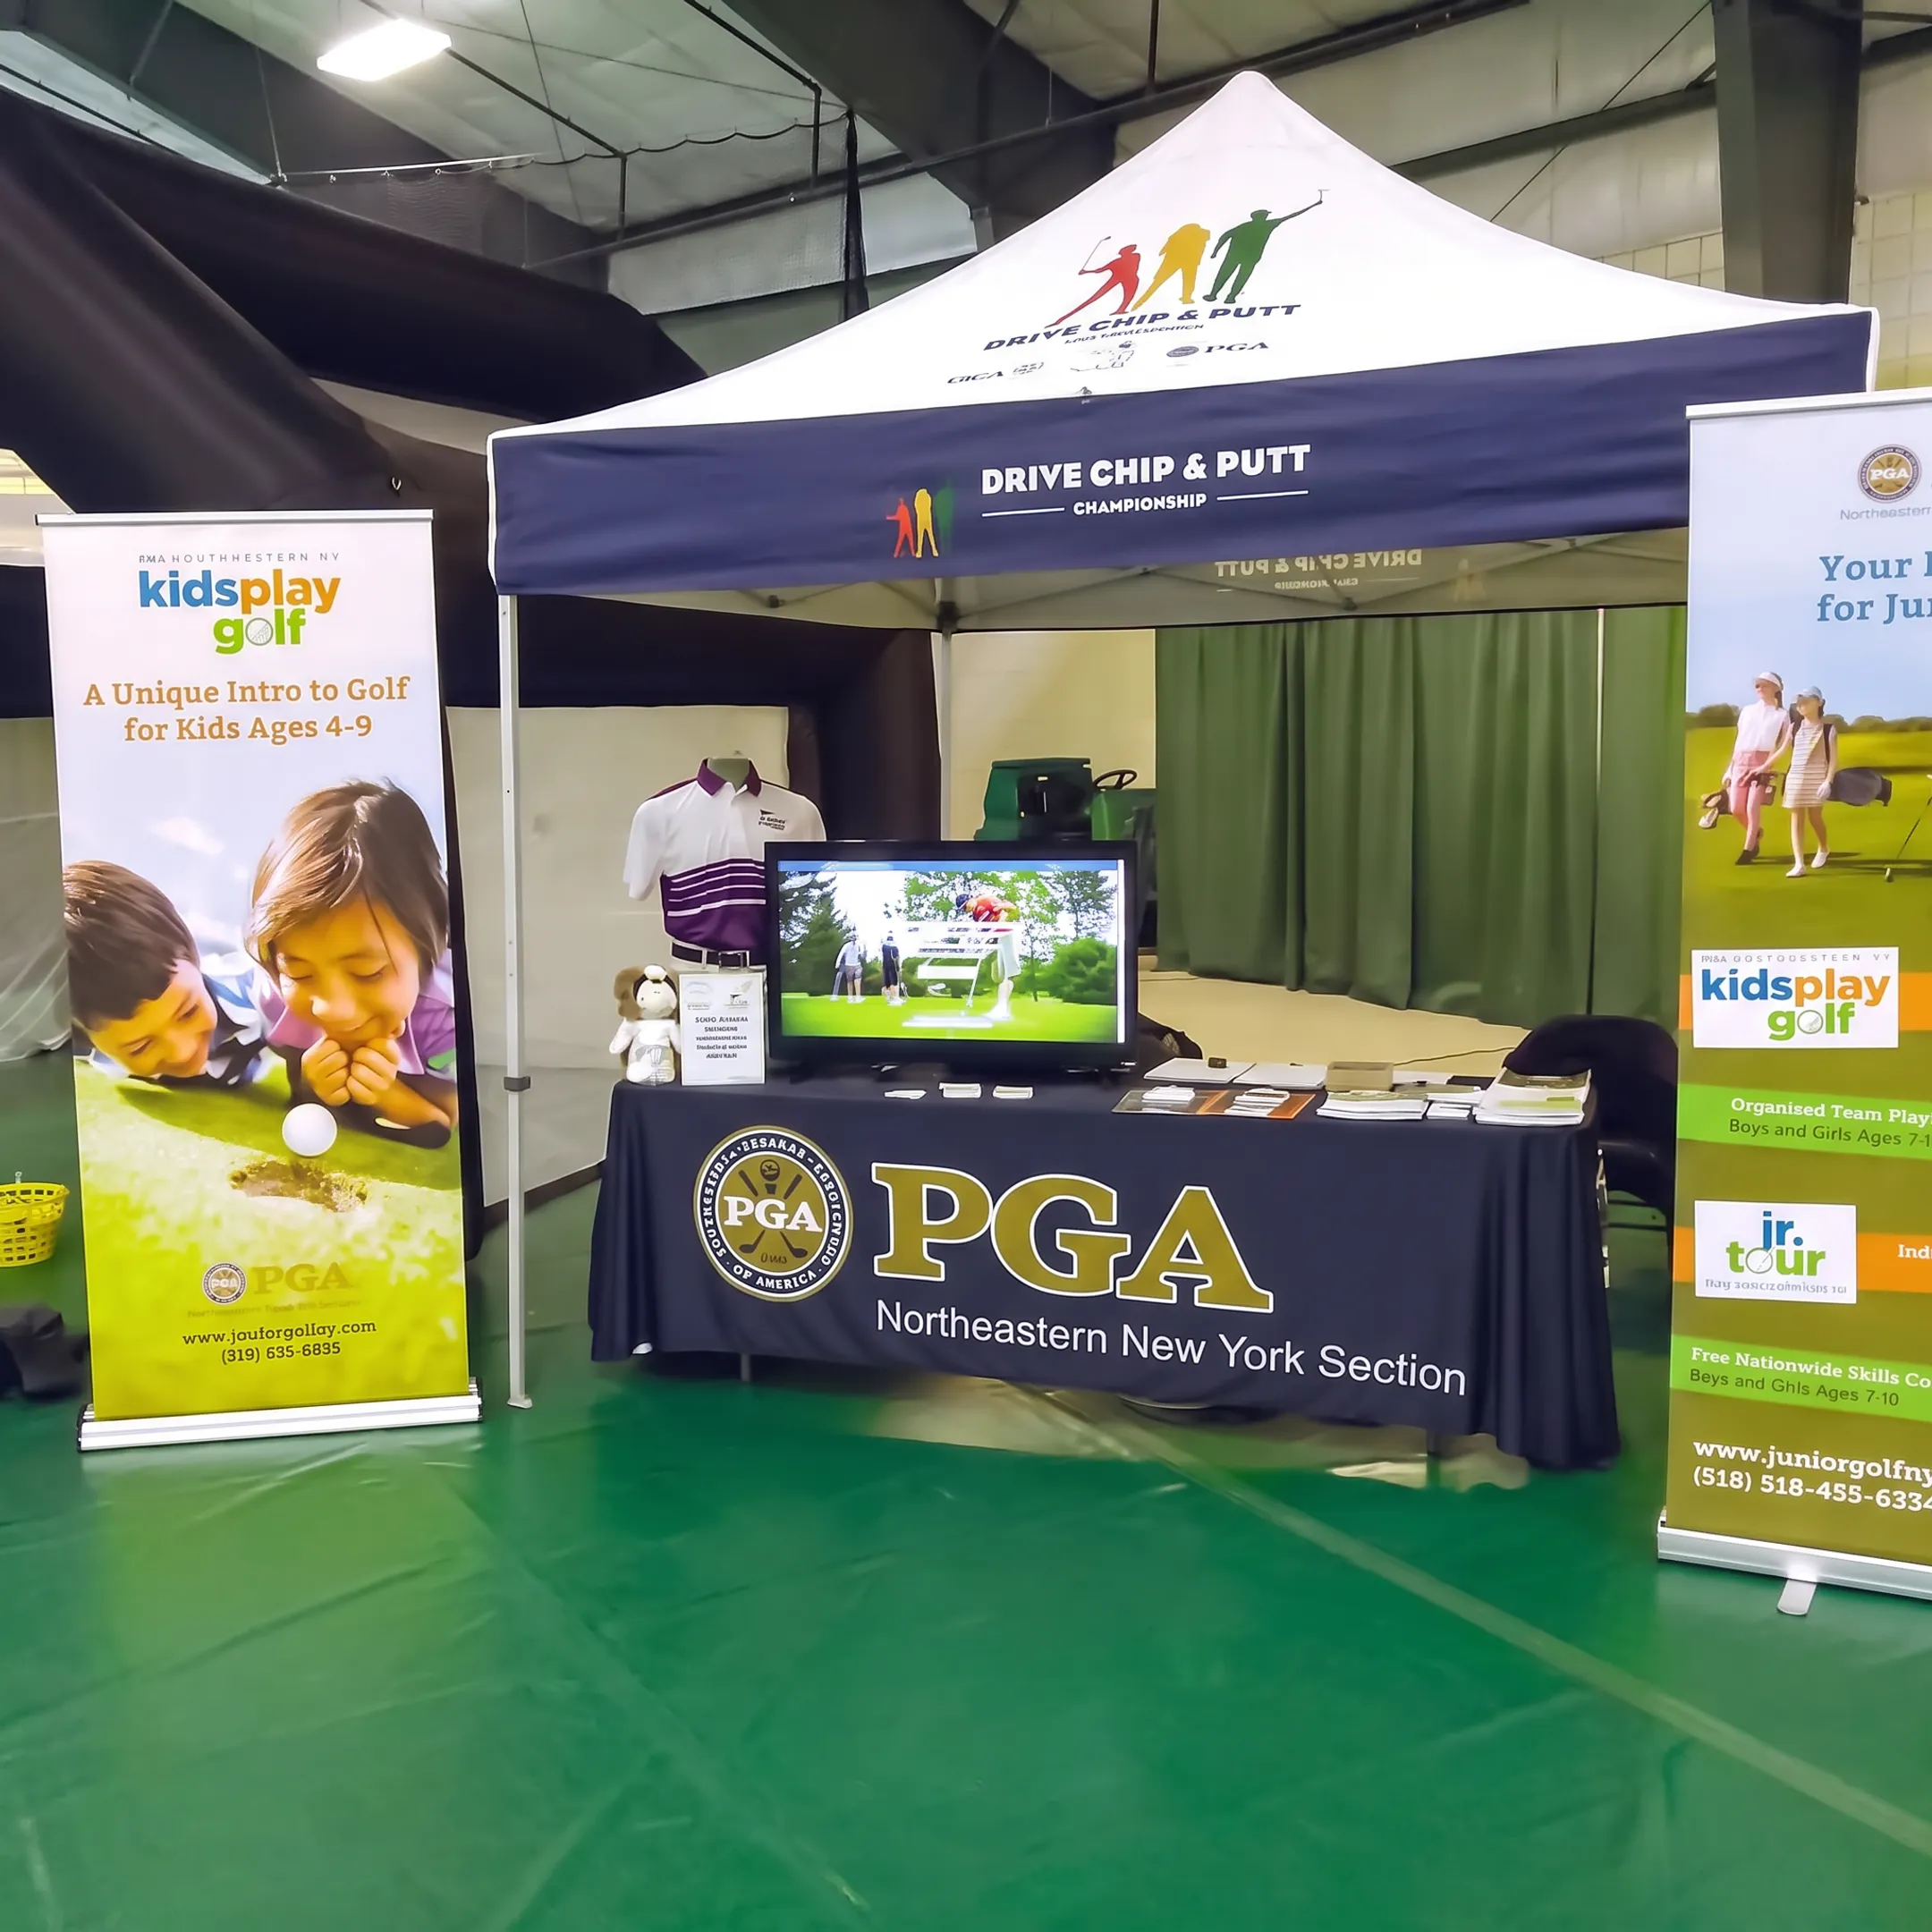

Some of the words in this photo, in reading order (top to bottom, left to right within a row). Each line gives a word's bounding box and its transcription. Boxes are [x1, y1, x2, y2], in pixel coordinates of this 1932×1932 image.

[984, 325, 1080, 351] DRIVE
[1089, 310, 1170, 332] CHIP
[1177, 309, 1203, 321] &
[1208, 304, 1301, 319] PUTT
[1203, 342, 1270, 353] PGA
[982, 461, 1082, 496] DRIVE
[1089, 453, 1174, 488] CHIP
[1182, 453, 1208, 480] &
[1216, 444, 1312, 478] PUTT
[1072, 493, 1207, 516] CHAMPIONSHIP
[1818, 555, 1912, 581] Your
[139, 569, 342, 614] kidsplay
[1817, 593, 1874, 622] for
[213, 608, 306, 655] golf
[83, 683, 106, 707] A
[112, 680, 219, 710] Unique
[227, 680, 302, 704] Intro
[309, 680, 338, 702] to
[347, 676, 411, 701] Golf
[124, 717, 168, 741] for
[176, 716, 240, 741] Kids
[248, 717, 318, 746] Ages
[326, 715, 373, 738] 4-9
[1701, 968, 1892, 1007] kidsplay
[1767, 1002, 1855, 1041] golf
[1731, 1097, 1826, 1117] Organised
[1831, 1104, 1883, 1122] Team
[1729, 1118, 1769, 1137] Boys
[1774, 1123, 1807, 1138] and
[1812, 1125, 1852, 1141] Girls
[1857, 1129, 1902, 1148] Ages
[723, 1195, 823, 1233] PGA
[1763, 1210, 1803, 1252] jr.
[871, 1162, 1274, 1313] PGA
[1725, 1241, 1826, 1276] tour
[252, 1262, 351, 1295] PGA
[756, 1270, 818, 1290] AMERICA
[222, 1346, 261, 1365] (319)
[266, 1342, 342, 1360] 635-6835
[876, 1299, 1108, 1355] Northeastern
[1121, 1324, 1206, 1364] New
[1218, 1332, 1304, 1376] York
[1318, 1344, 1467, 1396] Section
[1691, 1347, 1731, 1364] Free
[1734, 1352, 1843, 1378] Nationwide
[1848, 1366, 1900, 1385] Skills
[1734, 1375, 1766, 1390] and
[1816, 1385, 1860, 1402] Ages
[1866, 1389, 1900, 1407] 7-10
[1693, 1440, 1932, 1488] www.juniorgolfny
[1693, 1465, 1752, 1493] (518)
